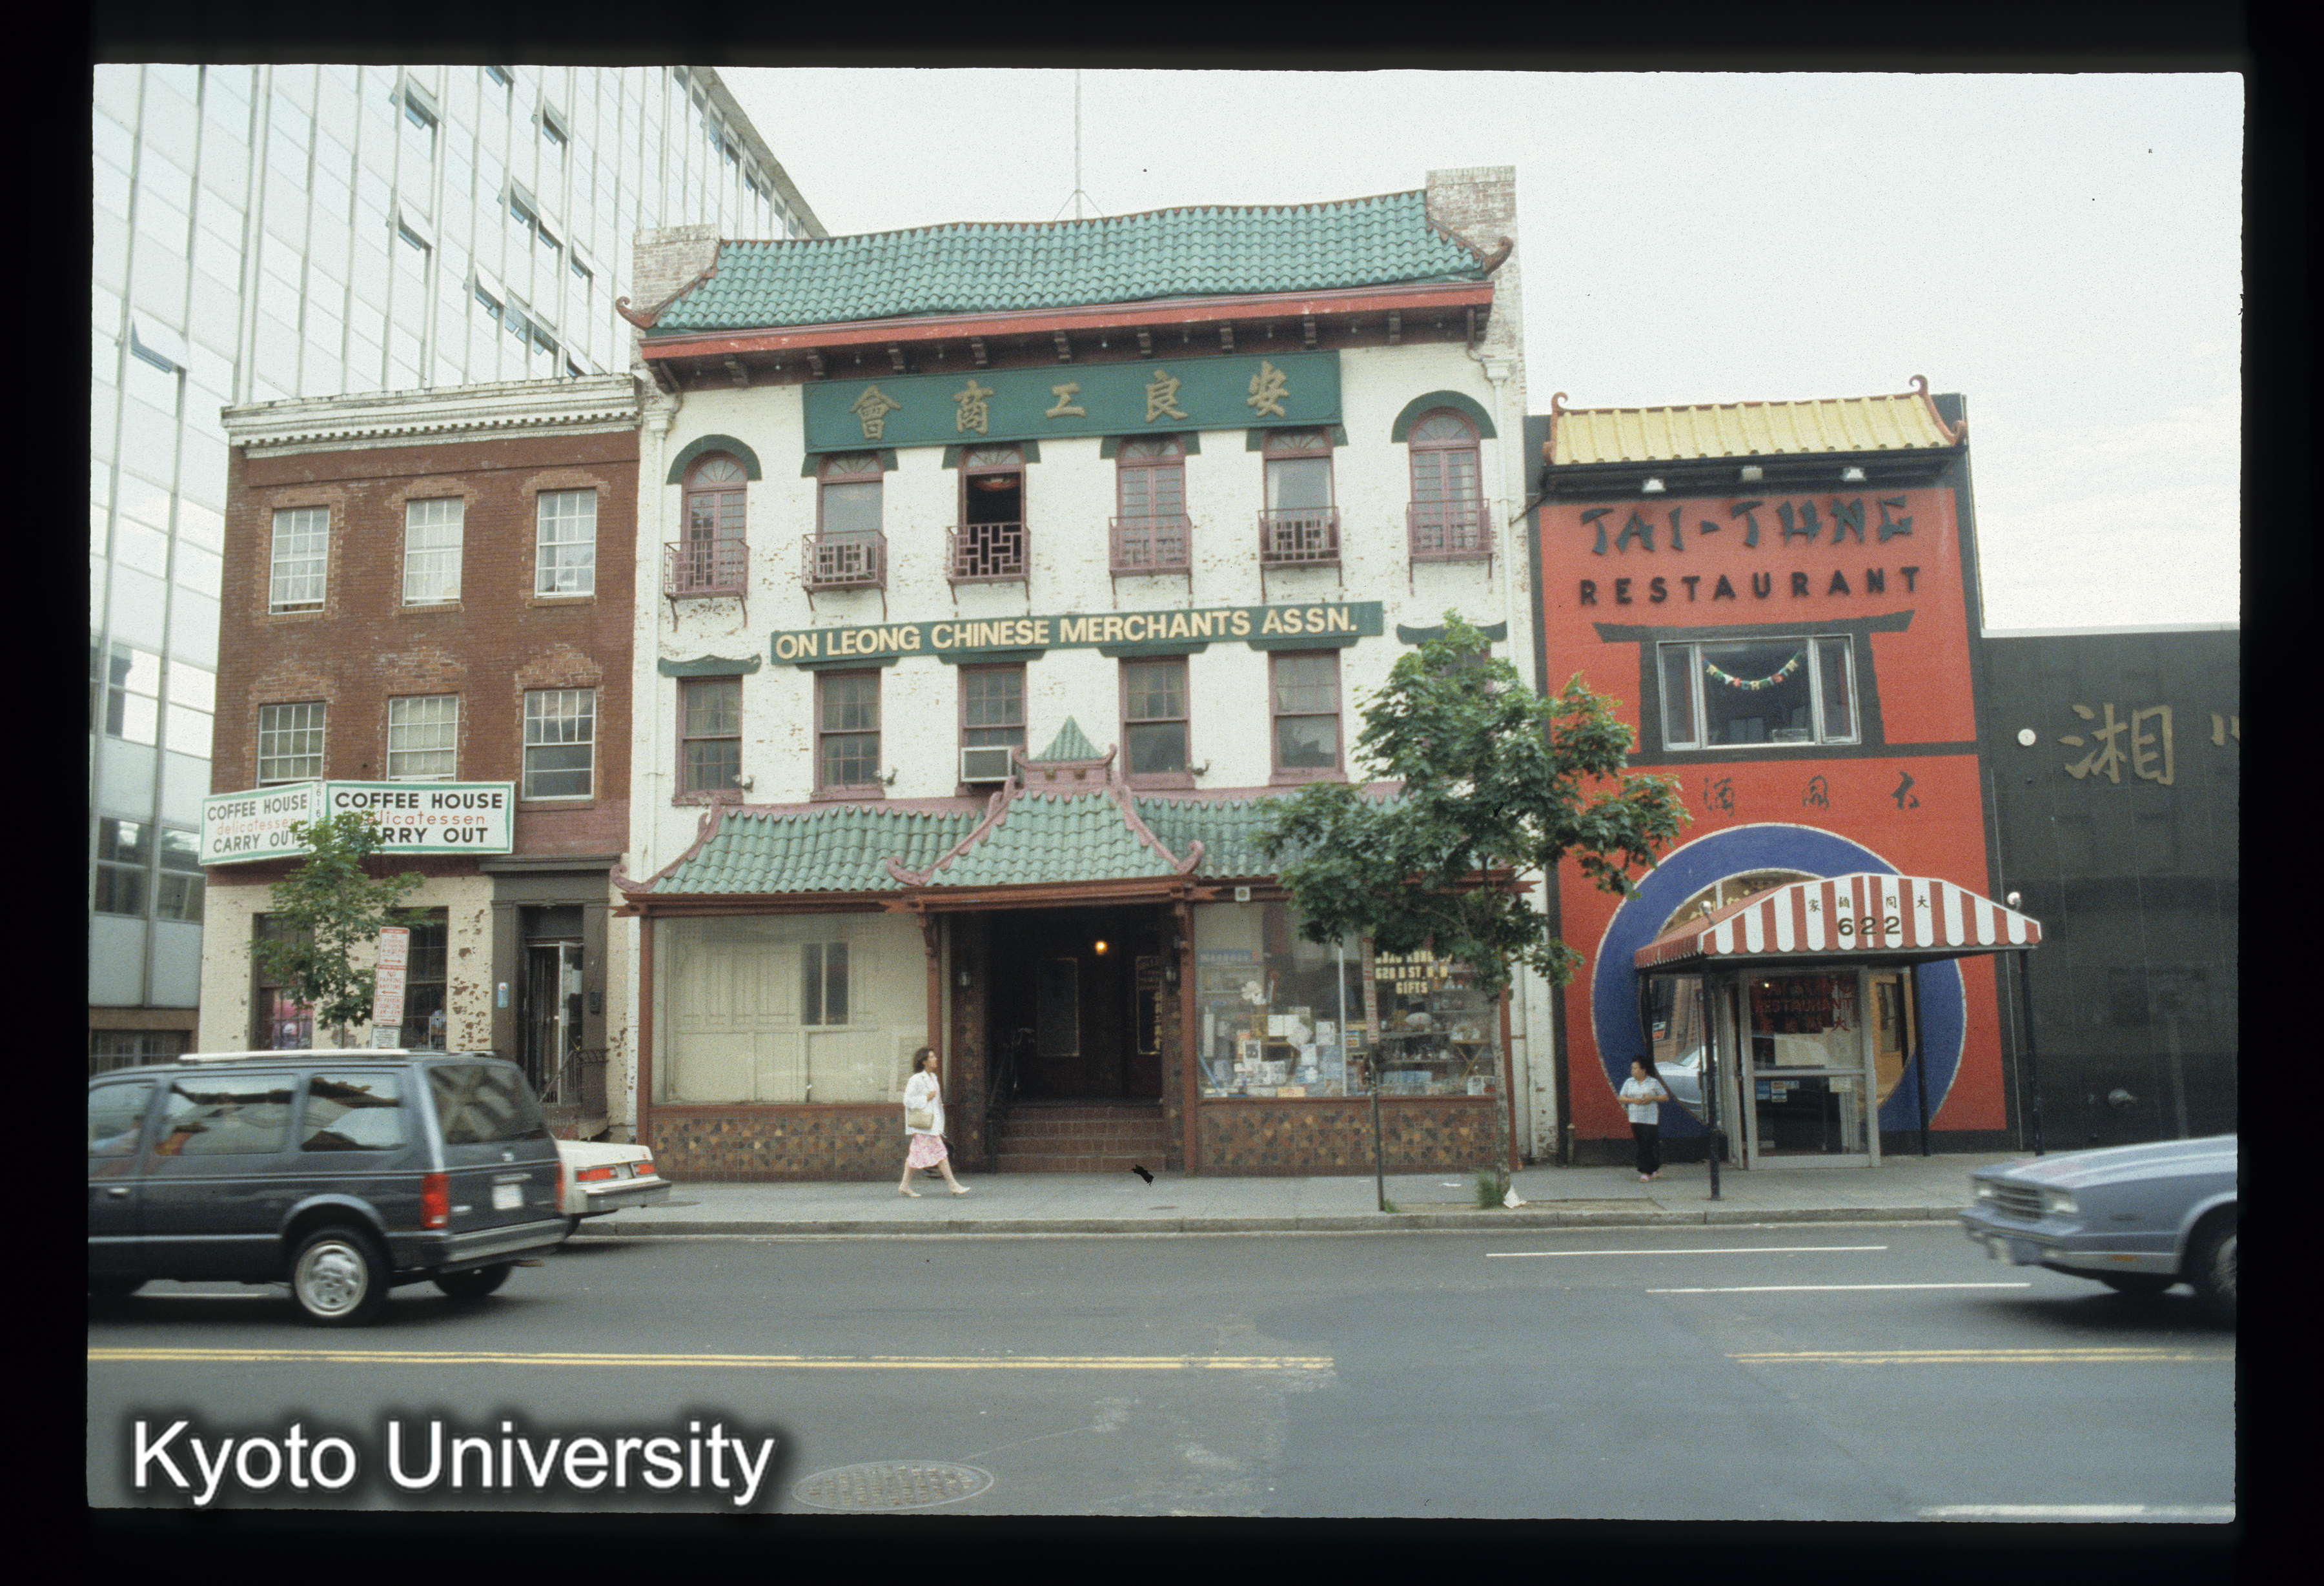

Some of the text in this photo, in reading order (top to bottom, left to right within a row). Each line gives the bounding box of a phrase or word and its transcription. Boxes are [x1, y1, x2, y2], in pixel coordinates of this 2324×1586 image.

[1580, 566, 1920, 605] RESTAURANT
[775, 607, 1357, 660] ON LEONG CHINESE MERCHANTS ASSN.
[208, 794, 307, 821] COFFEE HOUSE
[335, 793, 503, 809] COFFEE HOUSE
[217, 818, 296, 836] delicatessen
[443, 828, 488, 843] OUT
[213, 834, 260, 853] CARRY
[1838, 915, 1900, 937] 622
[1396, 981, 1428, 994] GIFTS
